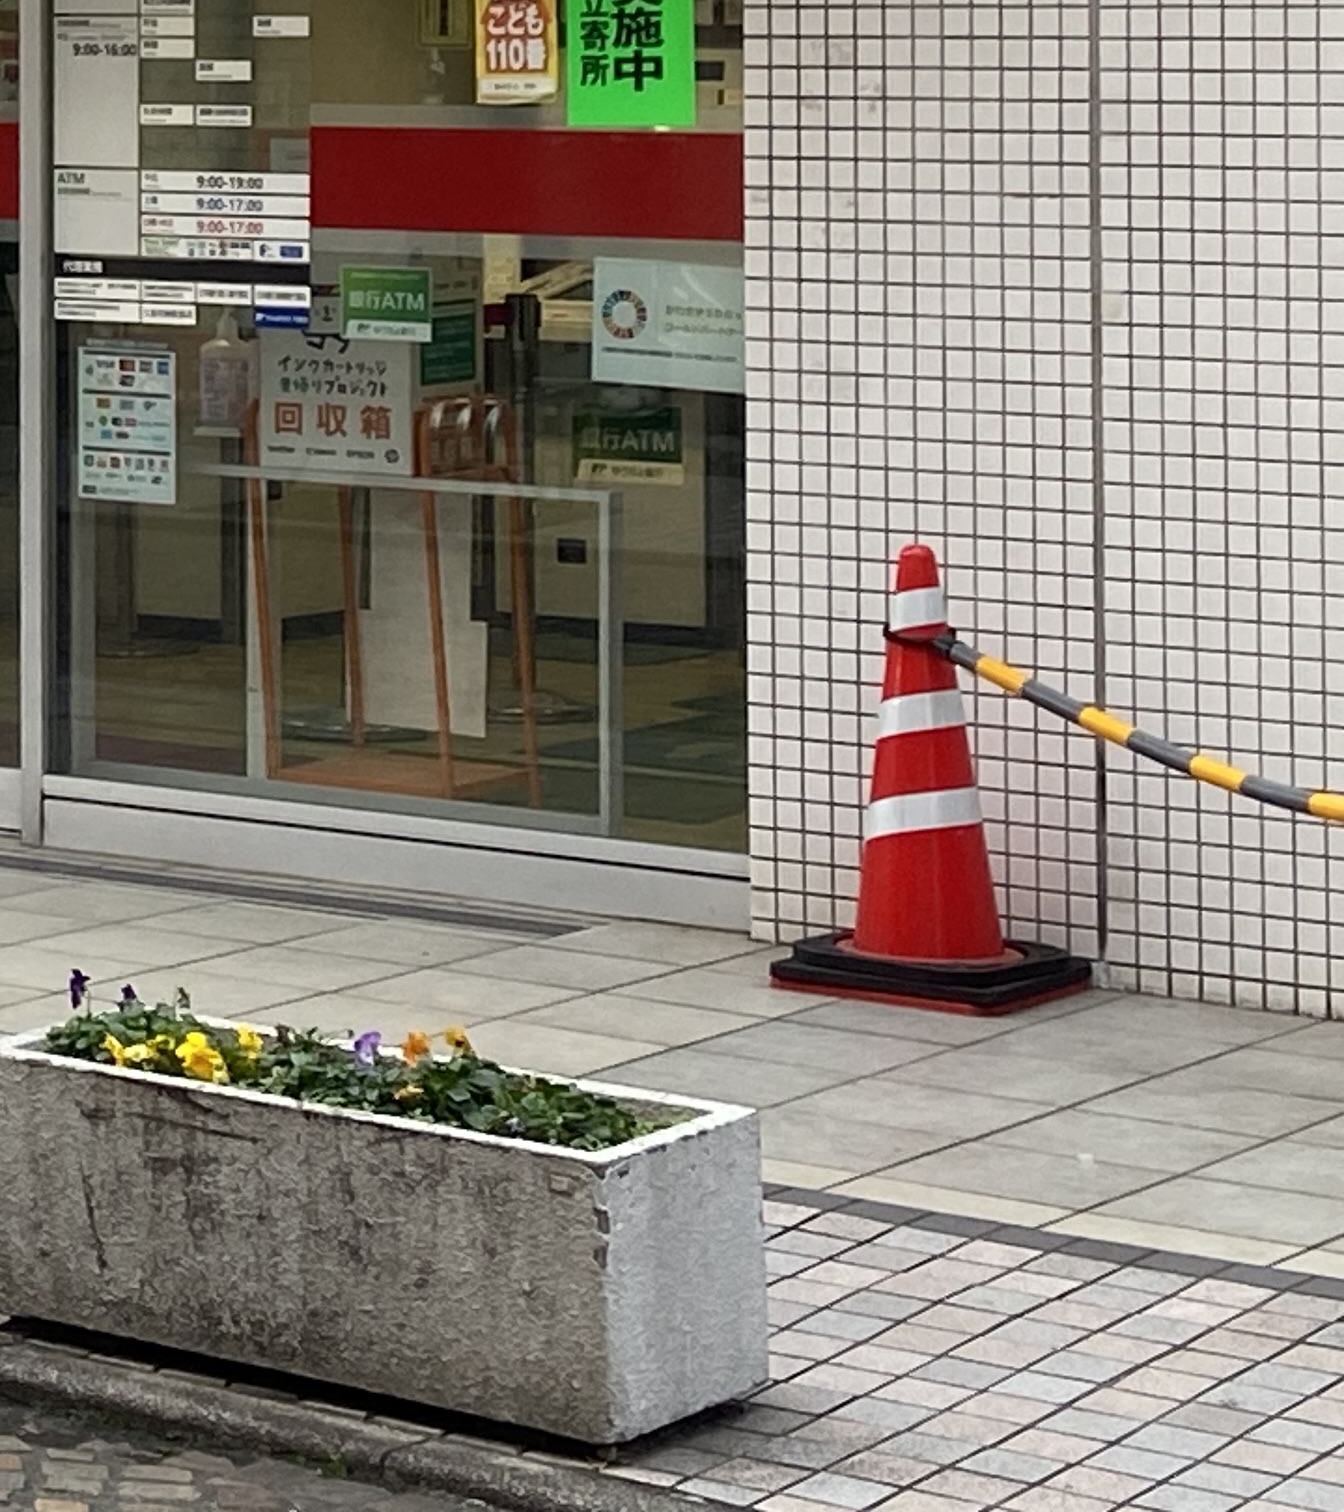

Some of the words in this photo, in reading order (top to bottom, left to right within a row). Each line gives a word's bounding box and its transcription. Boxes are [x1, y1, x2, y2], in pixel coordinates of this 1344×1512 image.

[487, 4, 544, 36] こども
[486, 38, 546, 71] 110番
[275, 402, 392, 439] 回収箱
